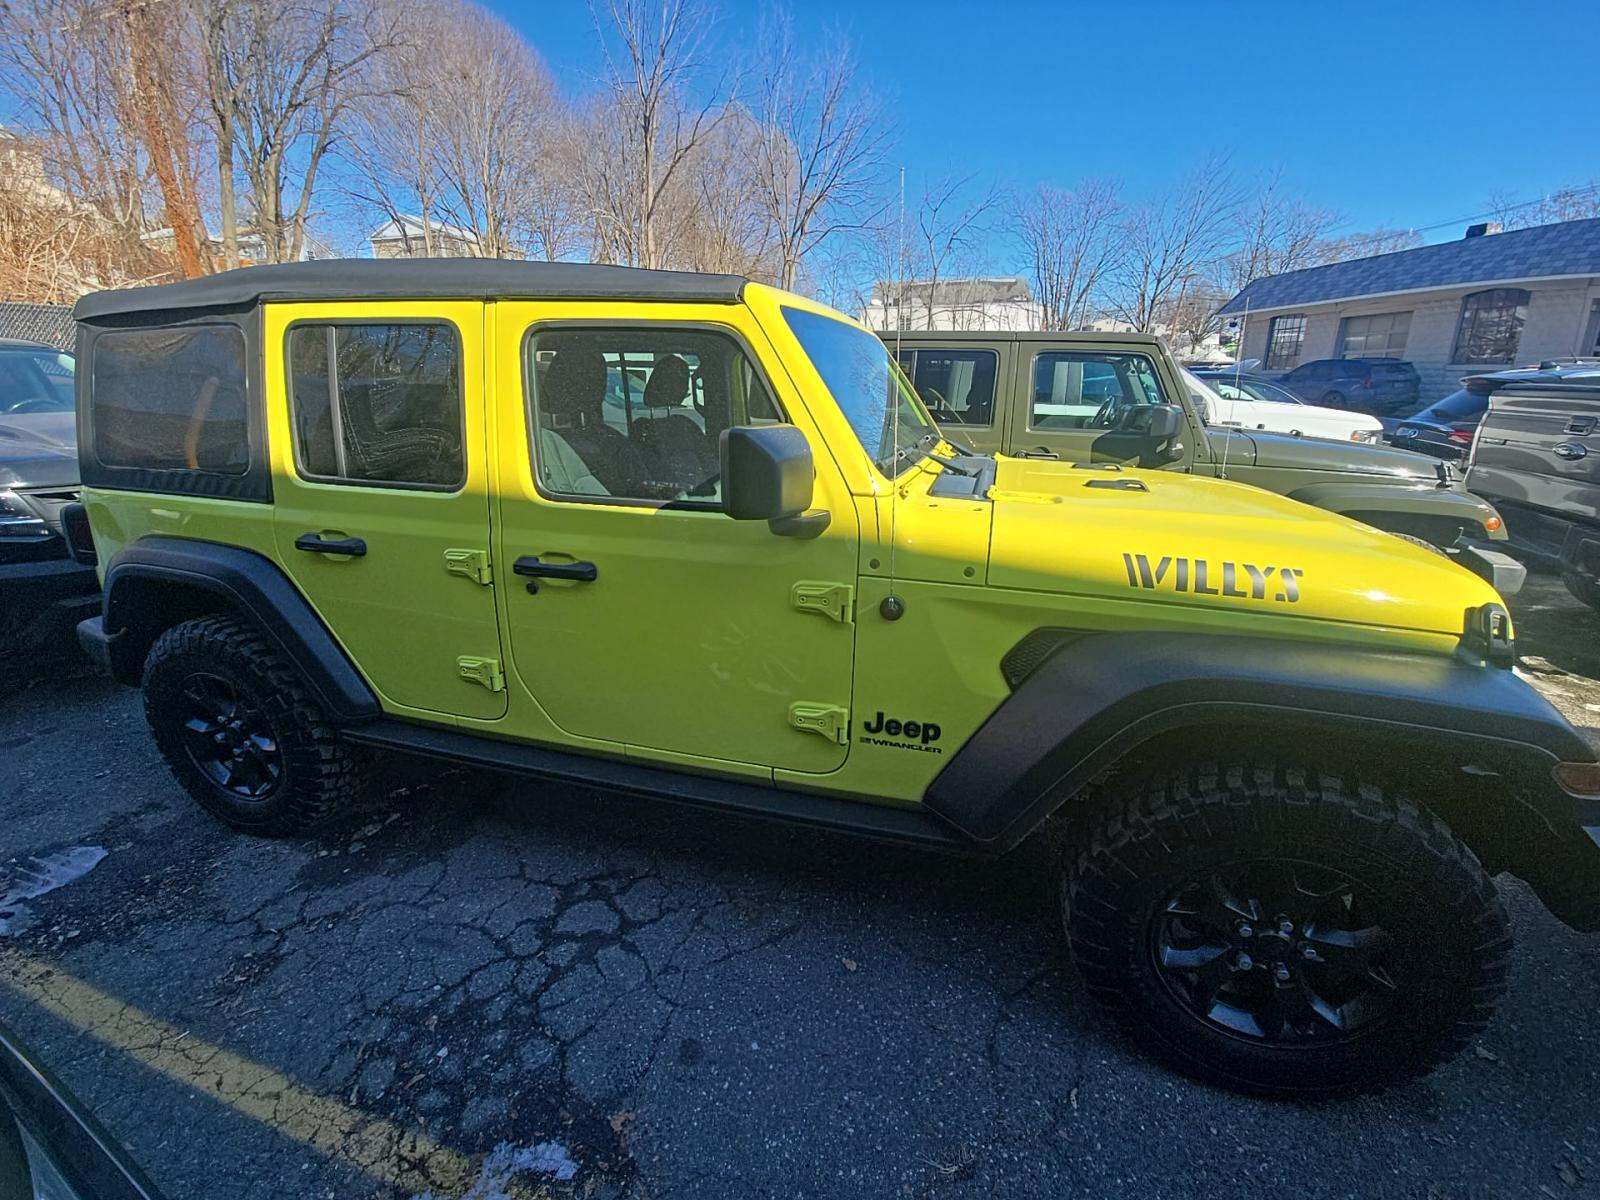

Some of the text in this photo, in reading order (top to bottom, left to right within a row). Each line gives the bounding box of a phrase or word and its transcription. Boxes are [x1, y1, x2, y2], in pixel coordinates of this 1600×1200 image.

[1122, 553, 1303, 603] WILLYS
[864, 711, 942, 744] Jeep
[872, 738, 942, 754] WRANGLER
